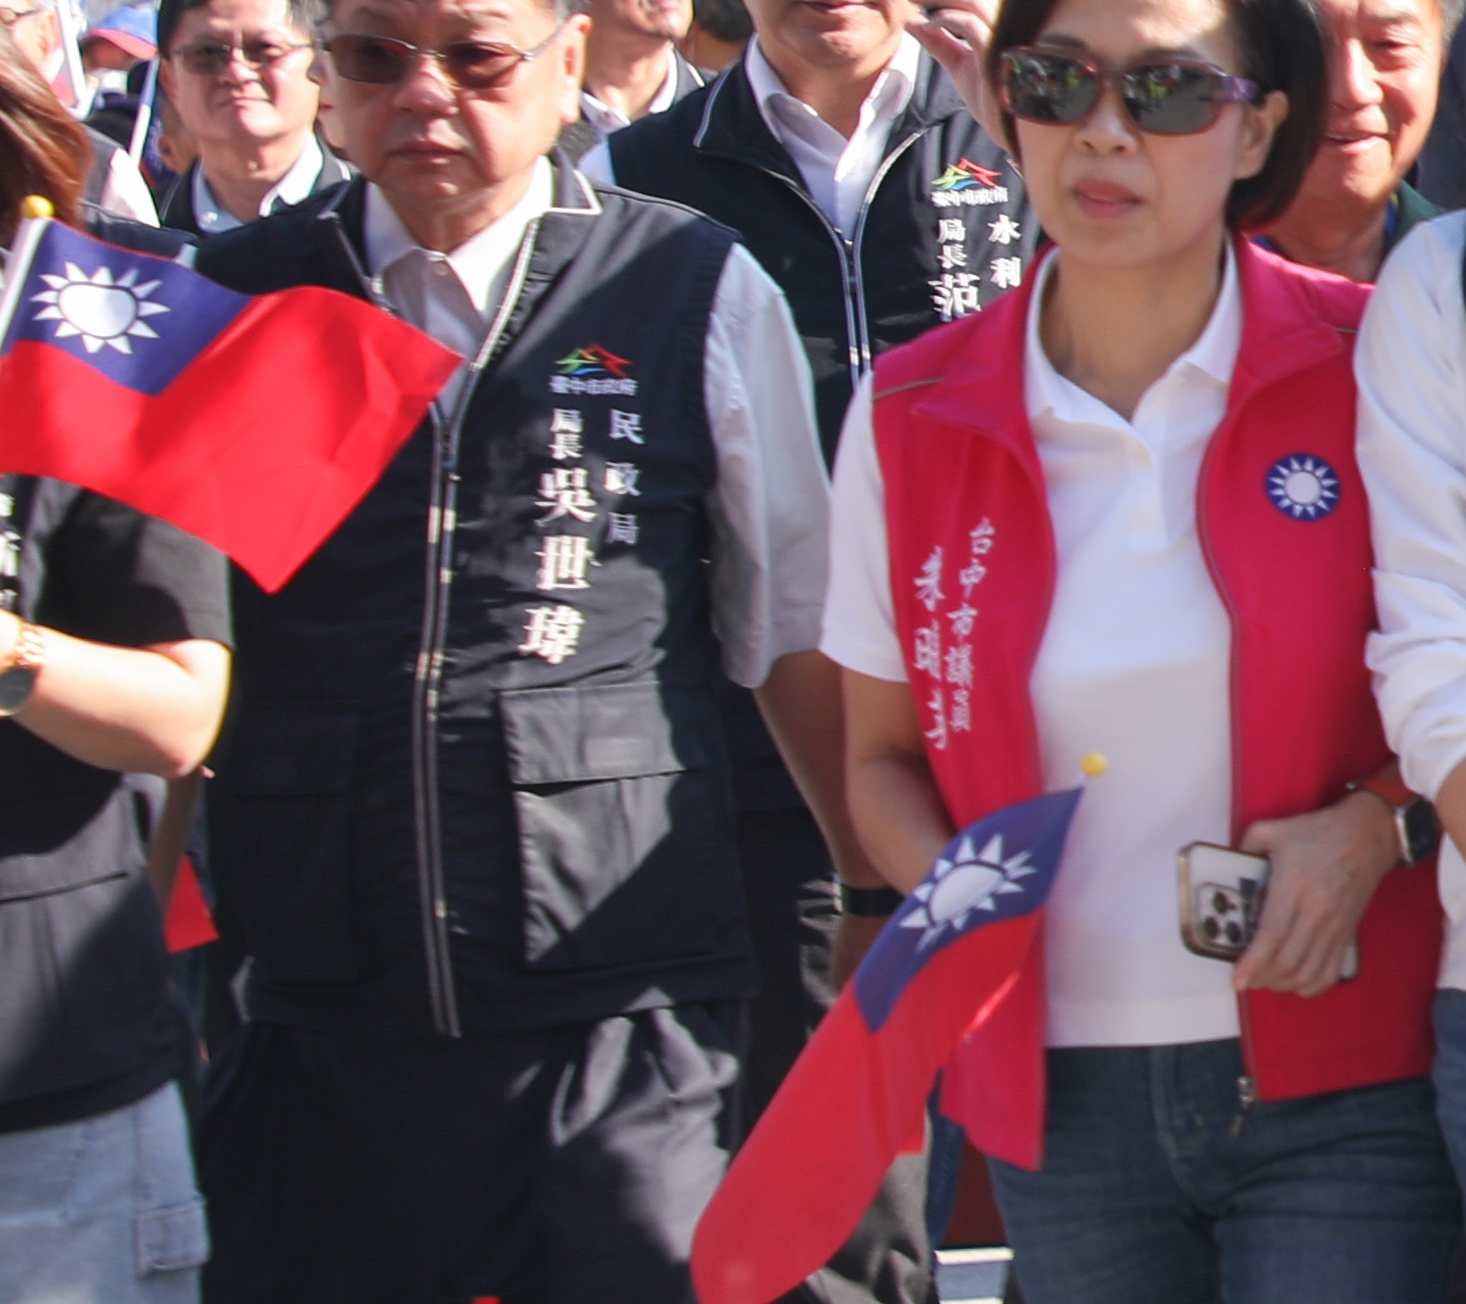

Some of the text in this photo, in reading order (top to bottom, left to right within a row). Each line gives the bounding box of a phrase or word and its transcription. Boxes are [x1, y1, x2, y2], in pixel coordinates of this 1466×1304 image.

[603, 408, 645, 546] 民政局
[942, 515, 996, 733] 台中市議員
